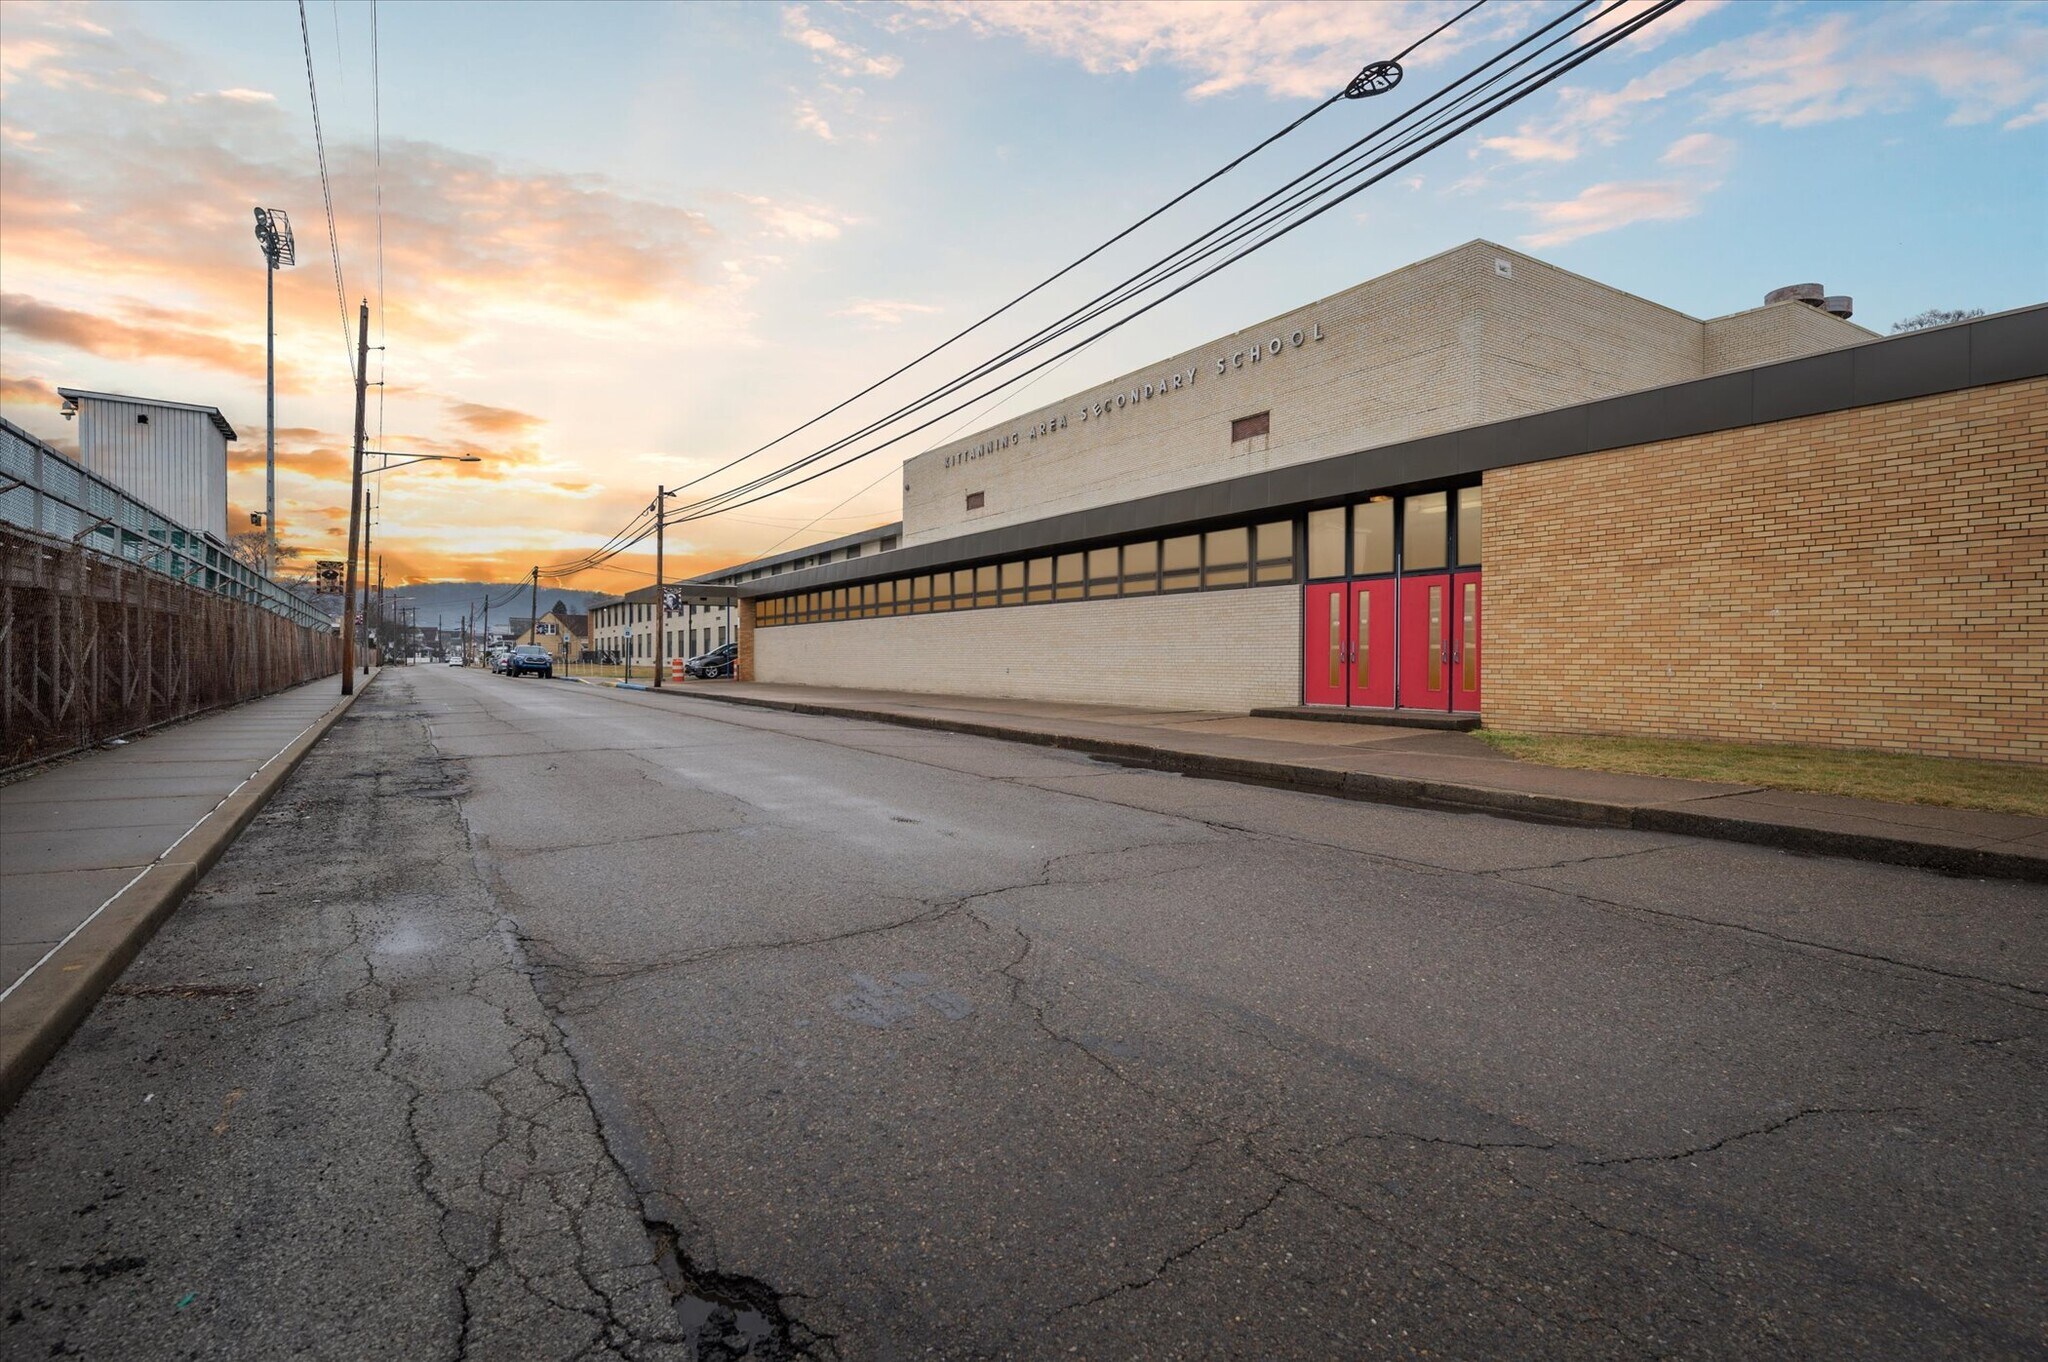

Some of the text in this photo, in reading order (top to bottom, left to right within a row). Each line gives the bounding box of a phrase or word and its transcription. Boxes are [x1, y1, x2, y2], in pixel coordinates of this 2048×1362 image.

[944, 323, 1325, 469] KITTANNING AREA SECONDARY SCHOOL
